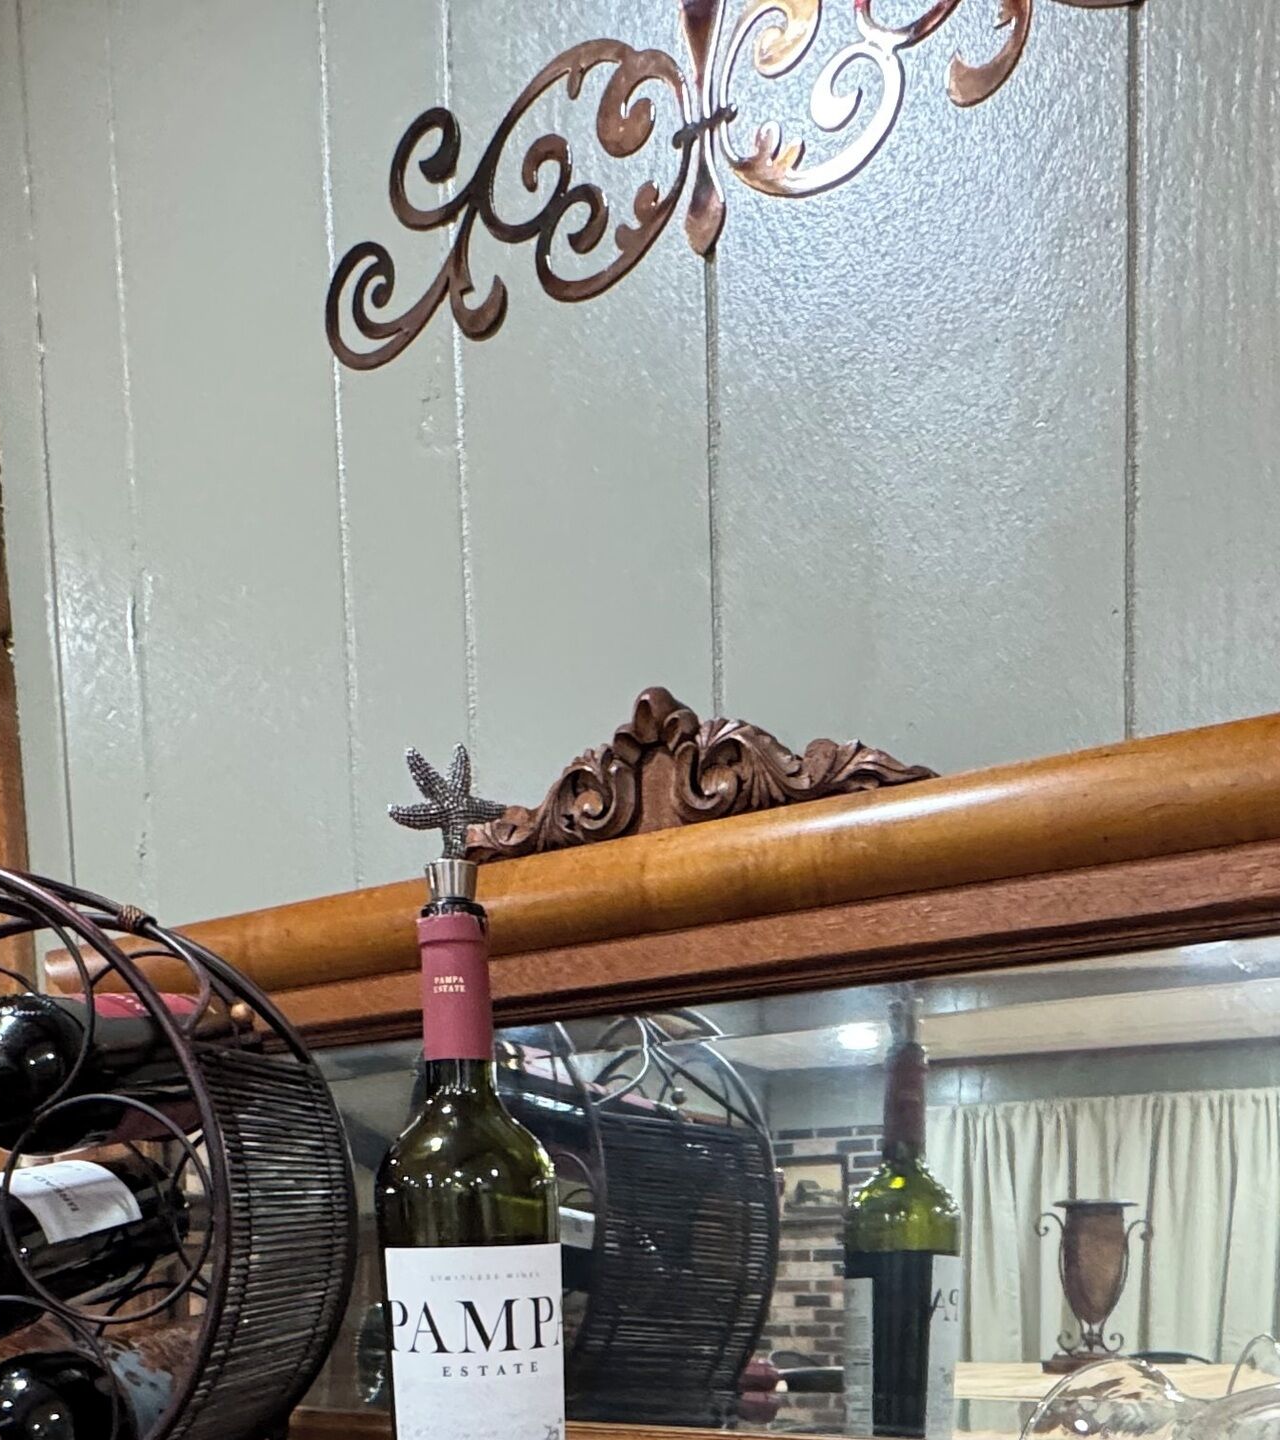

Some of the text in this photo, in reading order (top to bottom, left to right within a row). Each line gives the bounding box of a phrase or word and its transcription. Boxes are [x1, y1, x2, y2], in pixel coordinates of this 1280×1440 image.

[433, 975, 465, 985] PAMPA
[433, 984, 466, 994] ESTATE
[442, 1361, 539, 1377] ESTATE
